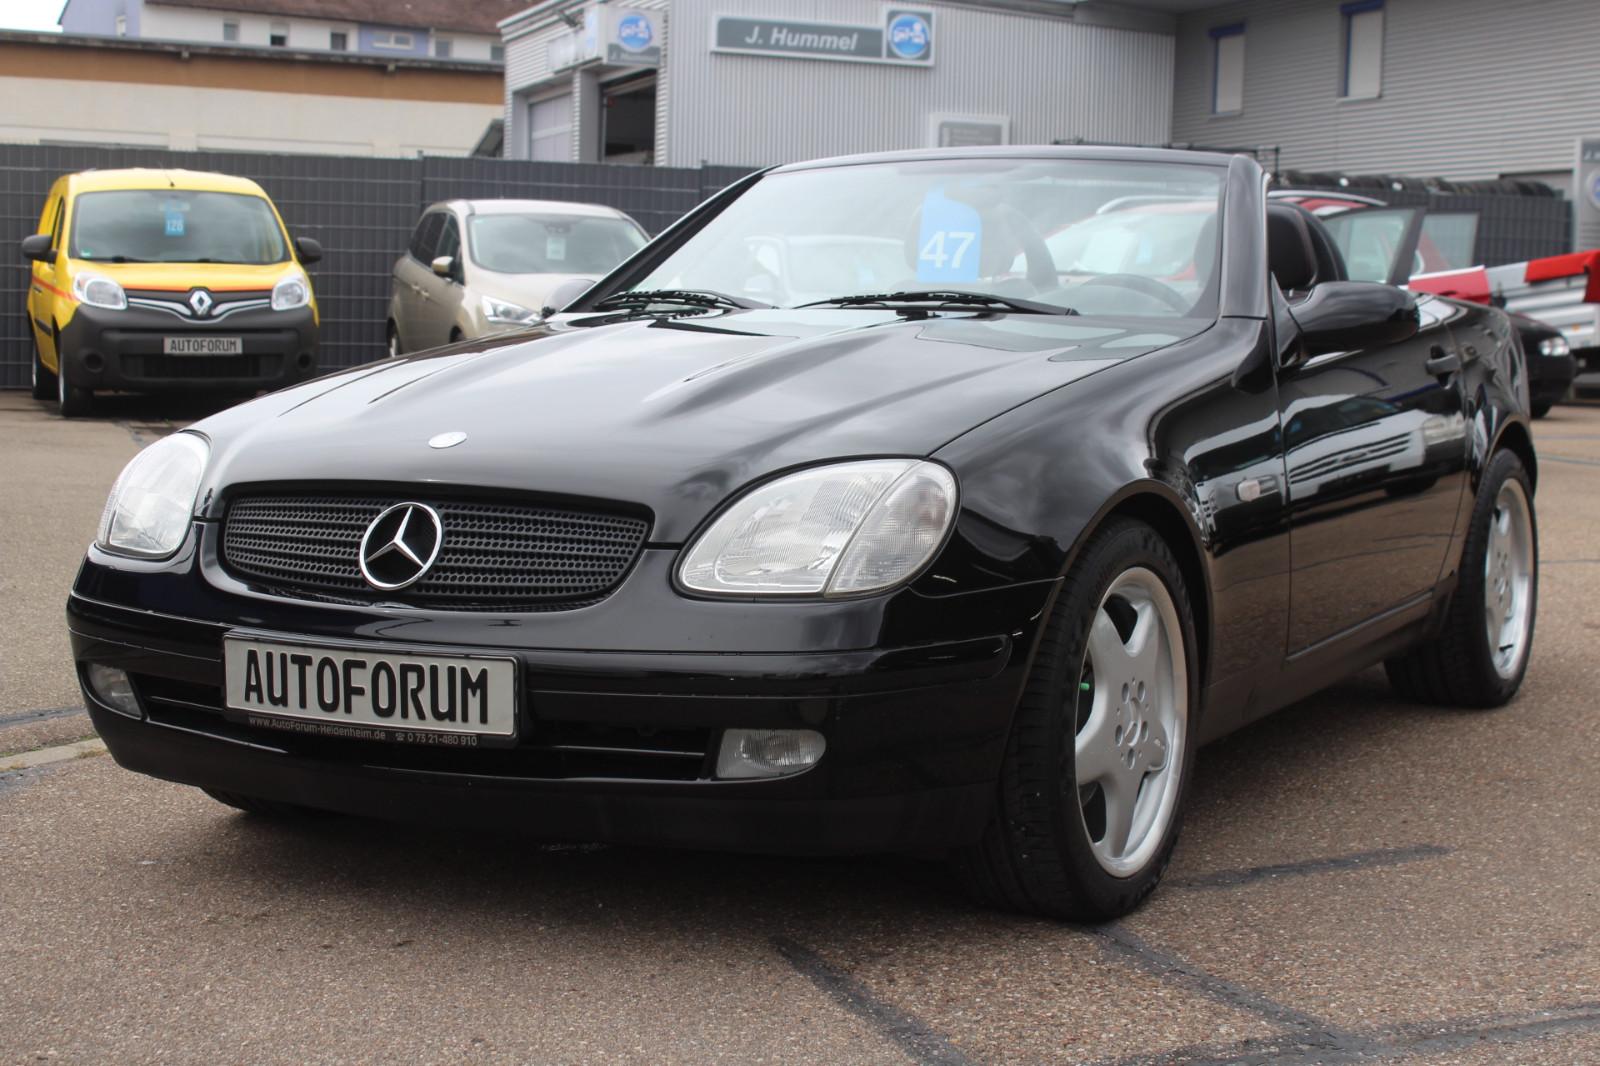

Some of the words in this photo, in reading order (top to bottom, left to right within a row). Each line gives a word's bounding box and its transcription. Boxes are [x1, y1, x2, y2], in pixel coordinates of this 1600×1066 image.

[745, 27, 763, 44] J.
[770, 28, 858, 50] Hummel
[920, 231, 976, 268] 47
[170, 339, 238, 352] AUTOFORUM
[245, 649, 488, 724] AUTOFORUM
